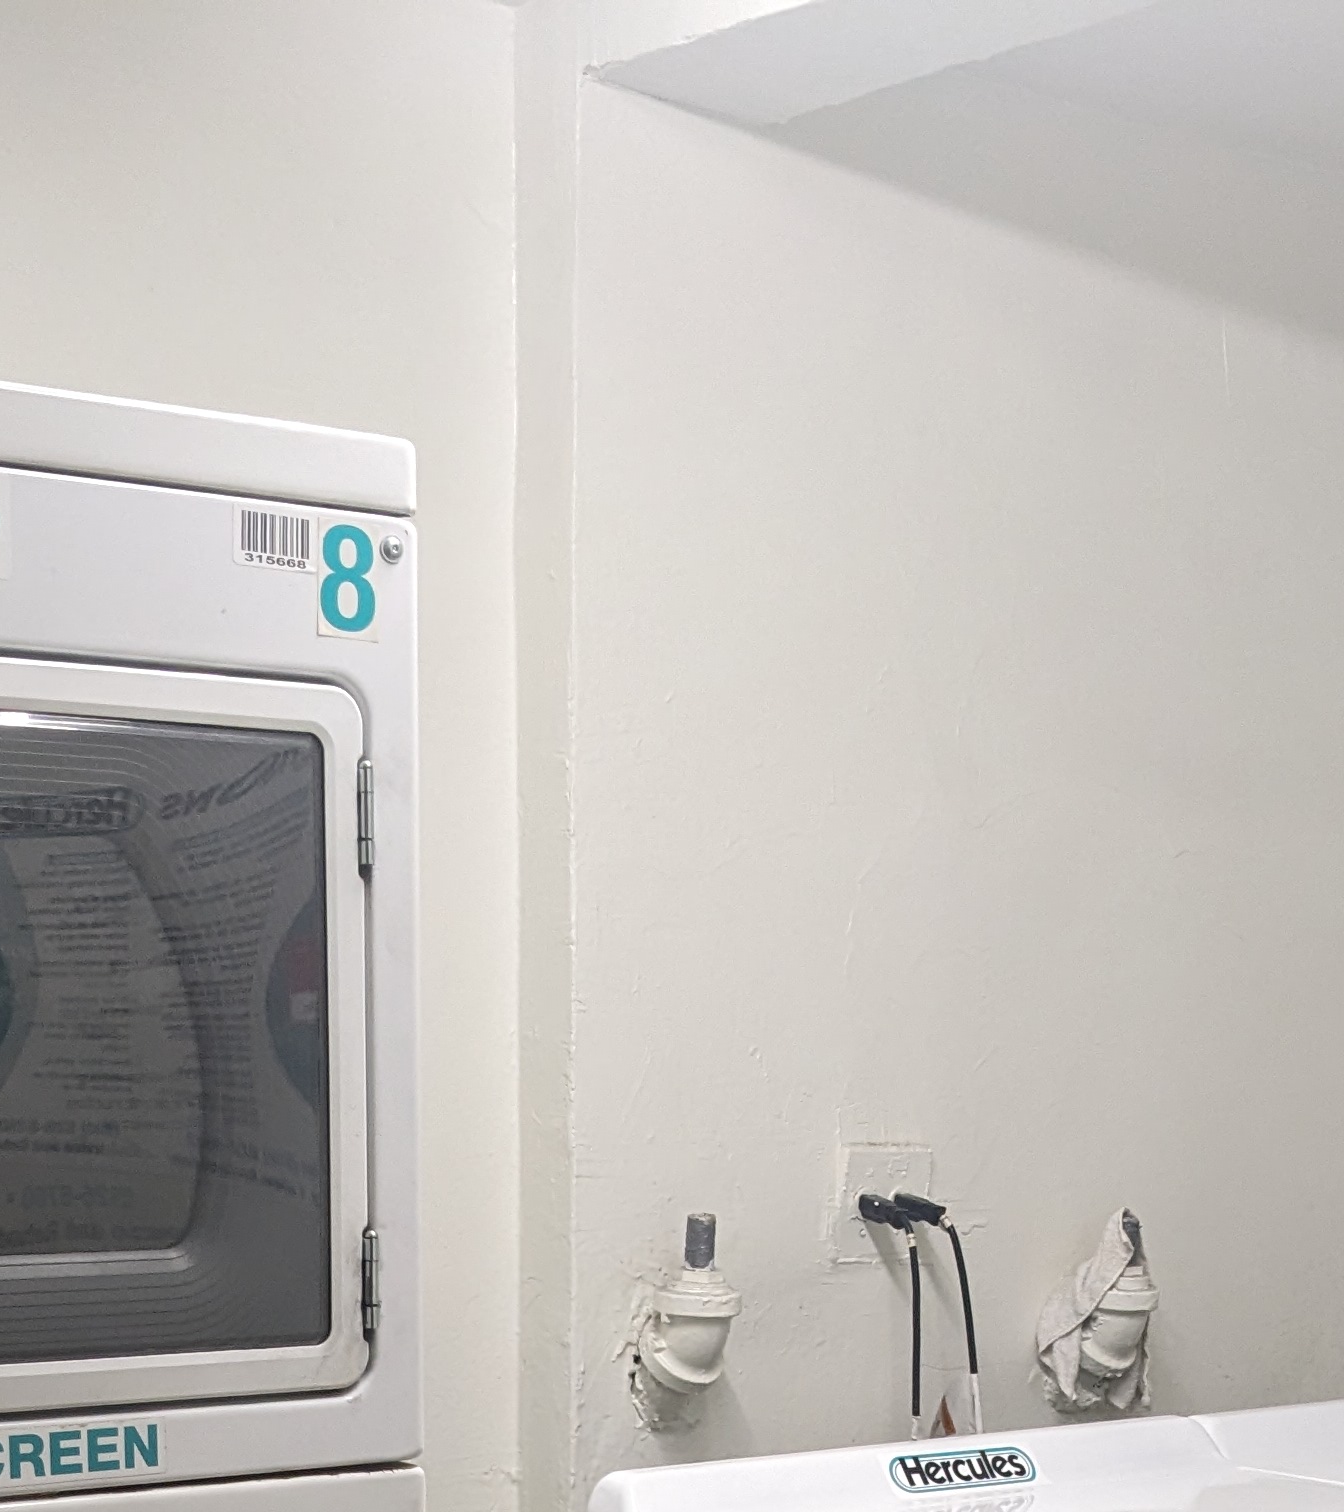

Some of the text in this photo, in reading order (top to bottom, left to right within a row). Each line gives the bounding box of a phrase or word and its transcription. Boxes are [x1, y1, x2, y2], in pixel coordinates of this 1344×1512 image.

[245, 553, 306, 569] 315668
[320, 524, 375, 632] 8
[900, 1450, 1027, 1487] Hercules
